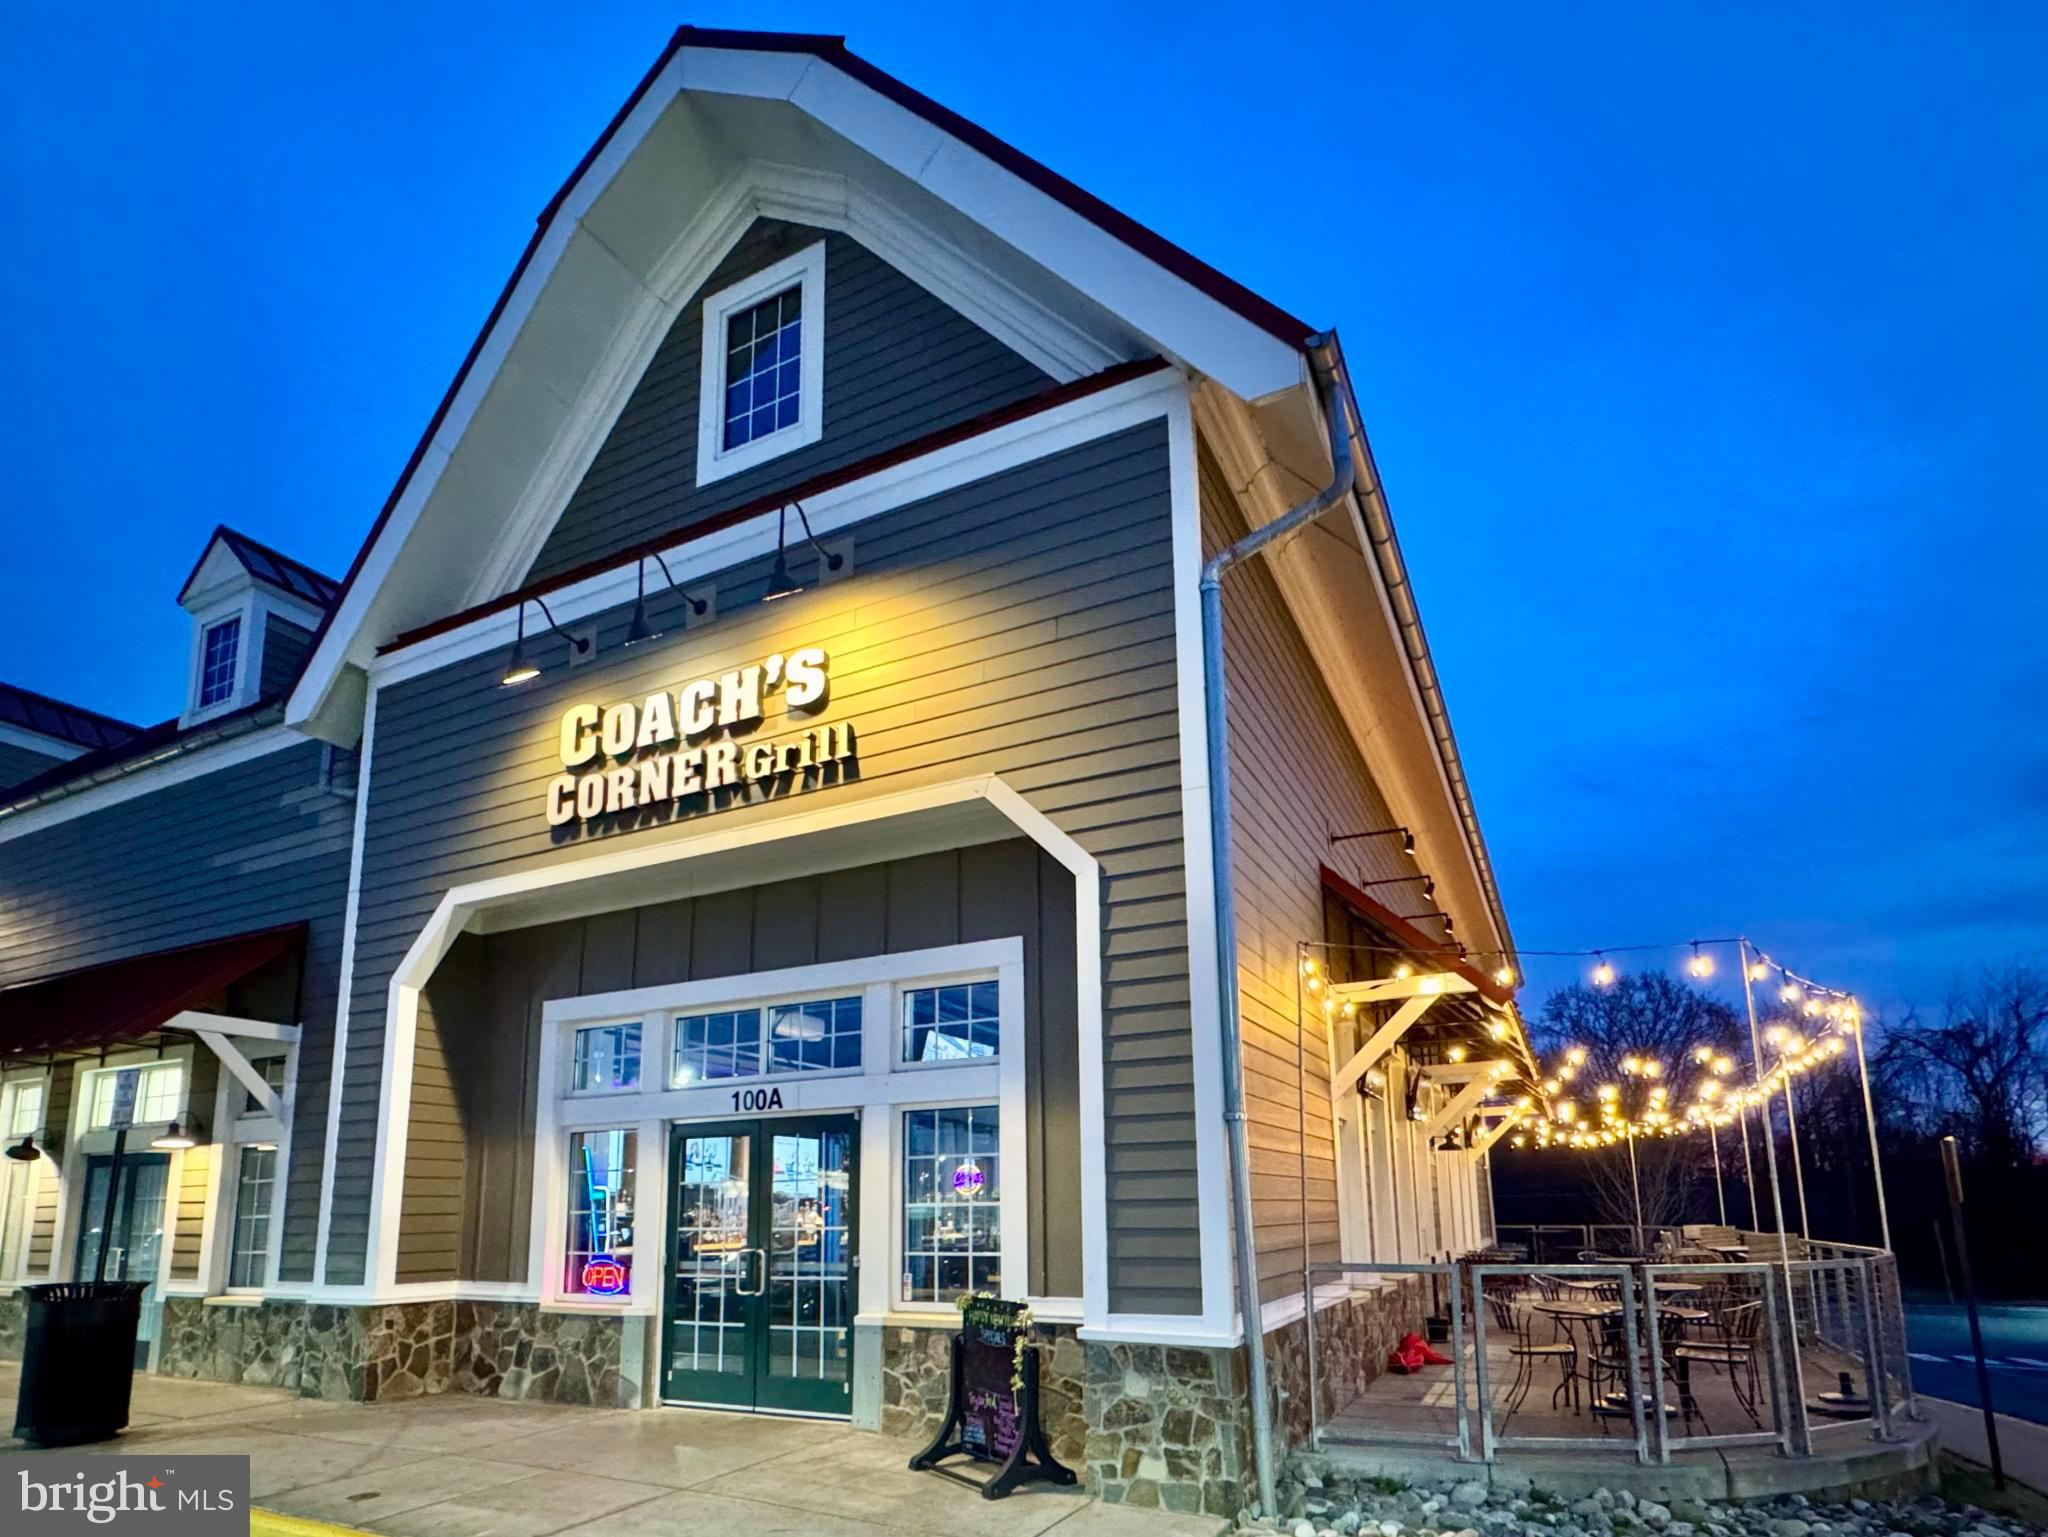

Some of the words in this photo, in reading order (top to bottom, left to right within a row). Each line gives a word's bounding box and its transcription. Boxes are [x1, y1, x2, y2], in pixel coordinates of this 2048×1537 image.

[559, 648, 829, 767] COACH'S
[546, 741, 742, 826] CORNER
[746, 722, 856, 779] Grill
[732, 1088, 783, 1112] 100A
[582, 1266, 625, 1288] OPEN
